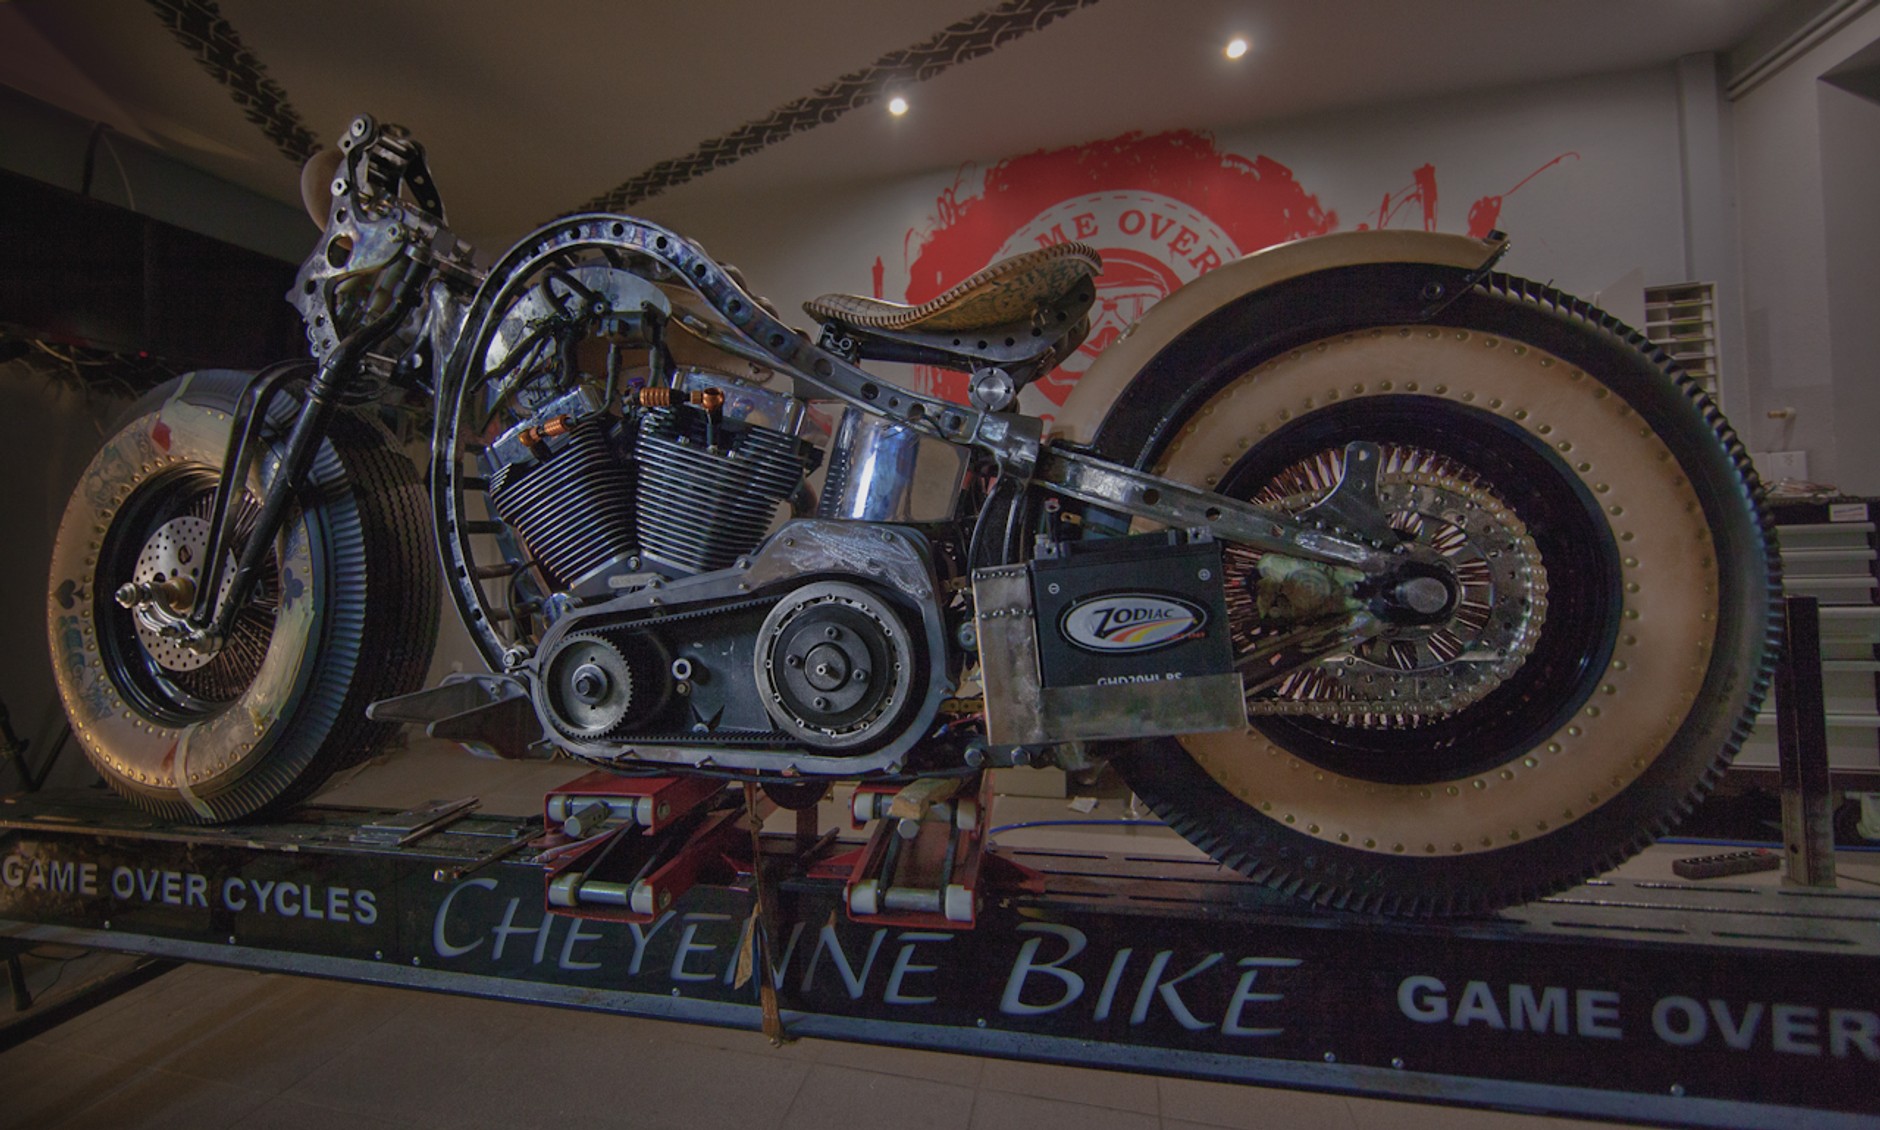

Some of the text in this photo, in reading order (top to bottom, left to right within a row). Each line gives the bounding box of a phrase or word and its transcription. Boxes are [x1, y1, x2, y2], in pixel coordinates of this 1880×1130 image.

[1034, 209, 1221, 274] ME OVER
[1093, 606, 1175, 639] ZODIAC
[1, 853, 379, 926] GAME OVER CYCLES
[432, 877, 1304, 1038] CHEYENNE BIKE
[1396, 974, 1880, 1062] GAME OVER
